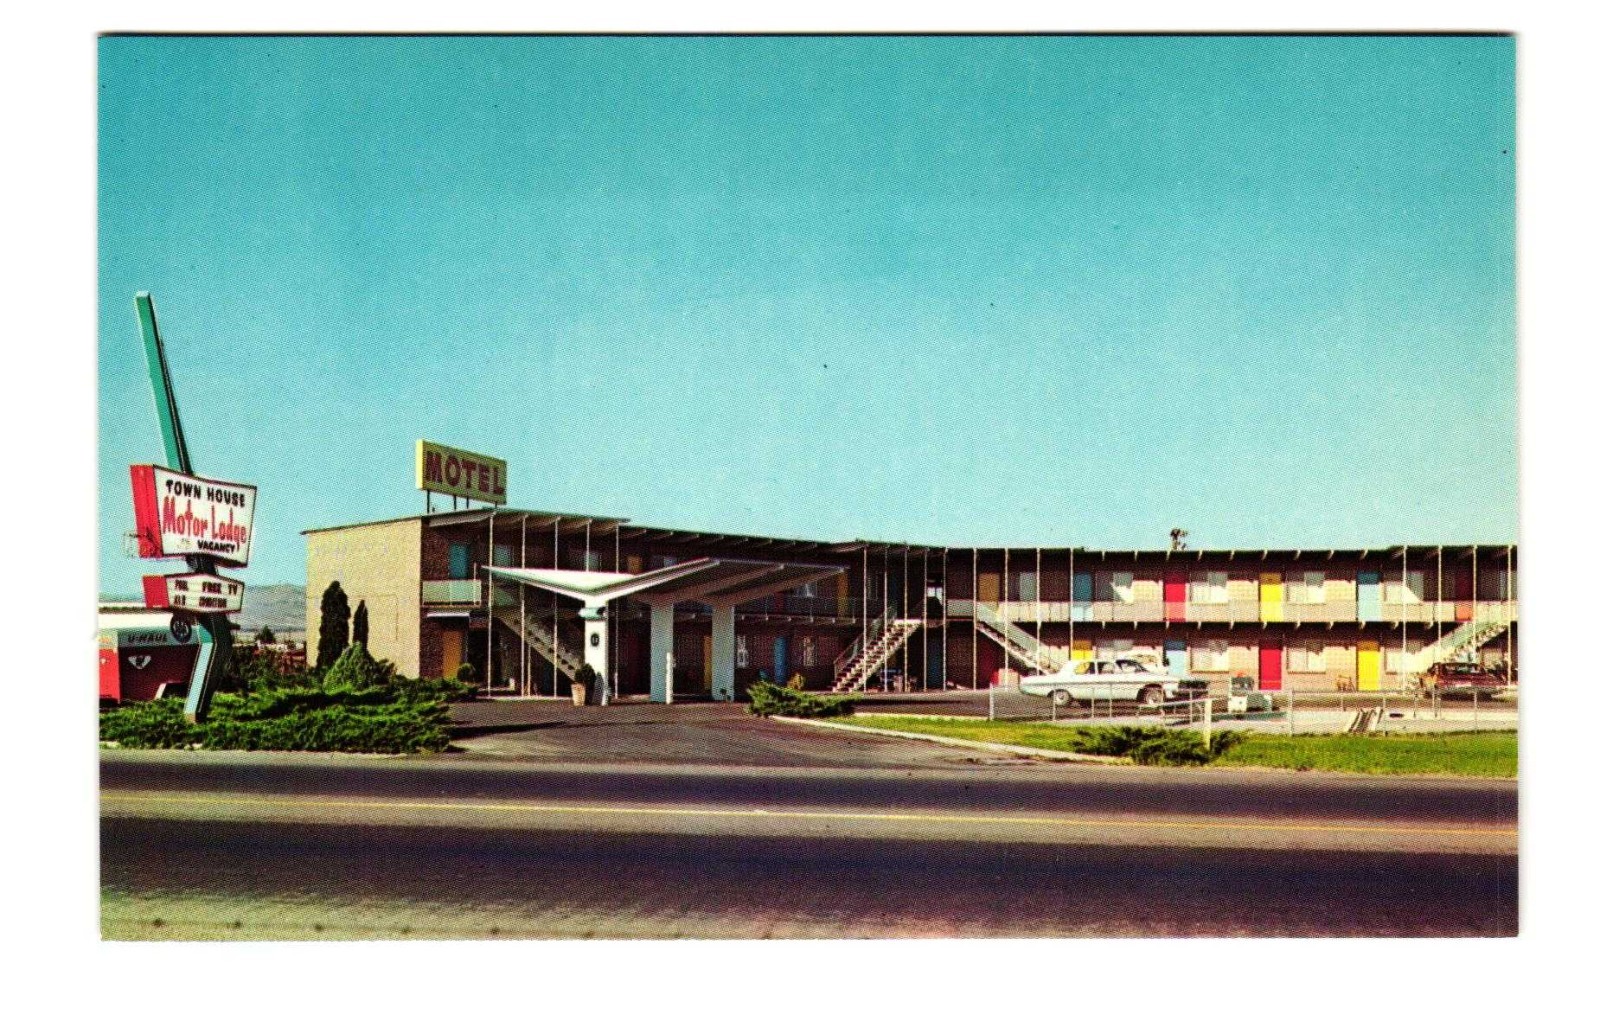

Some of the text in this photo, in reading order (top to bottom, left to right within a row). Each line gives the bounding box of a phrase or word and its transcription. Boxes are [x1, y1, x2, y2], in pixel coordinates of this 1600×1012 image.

[425, 450, 504, 495] MOTEL
[165, 480, 245, 508] TOWN HOUSE
[163, 495, 246, 552] Motor Lodge
[197, 540, 236, 554] VACANCY
[228, 583, 238, 595] TV
[128, 633, 168, 643] U-HAUL
